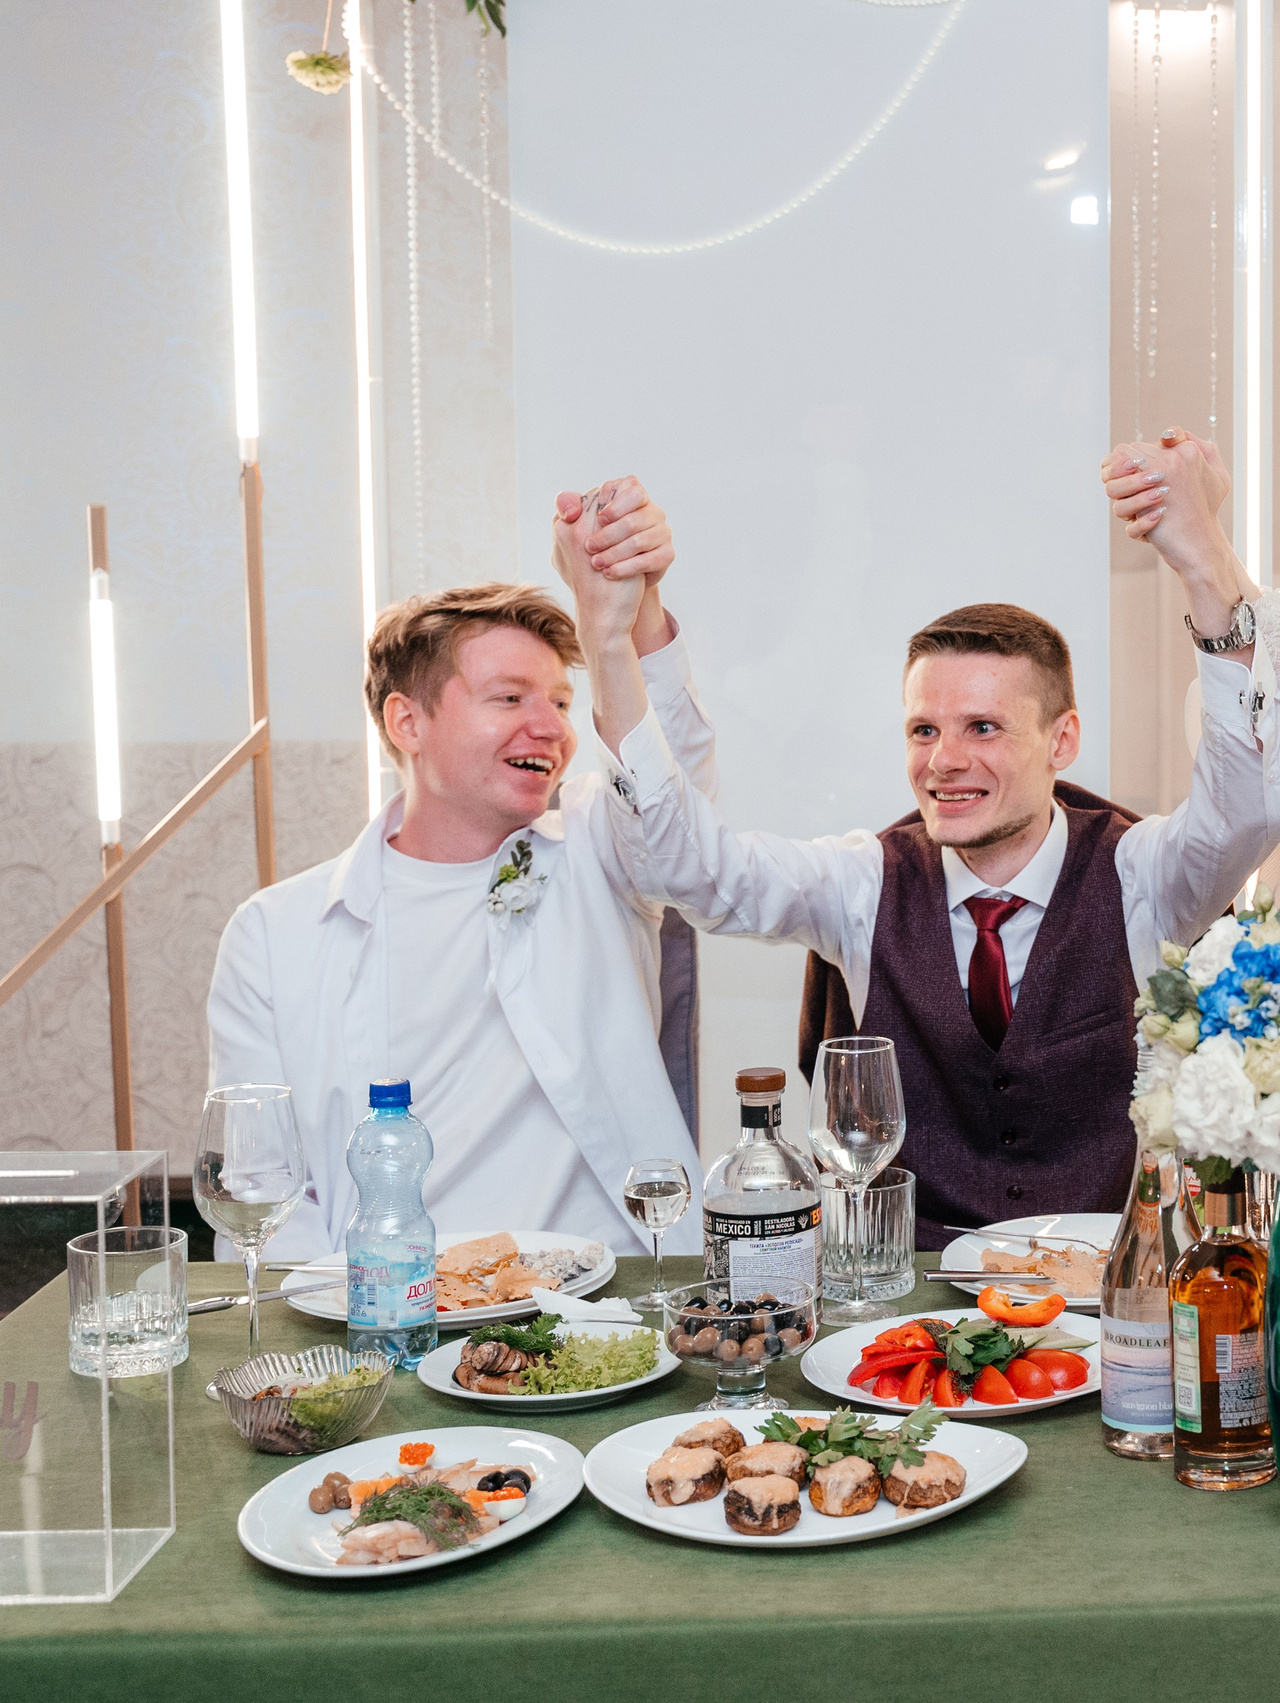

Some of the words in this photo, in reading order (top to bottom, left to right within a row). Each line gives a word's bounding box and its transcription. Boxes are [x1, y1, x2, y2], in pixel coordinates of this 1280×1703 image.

[764, 1216, 795, 1225] DESTILADORA
[775, 1221, 796, 1230] NICOLAS
[716, 1222, 751, 1236] MEXICO
[1105, 1331, 1169, 1347] BROADLEAF
